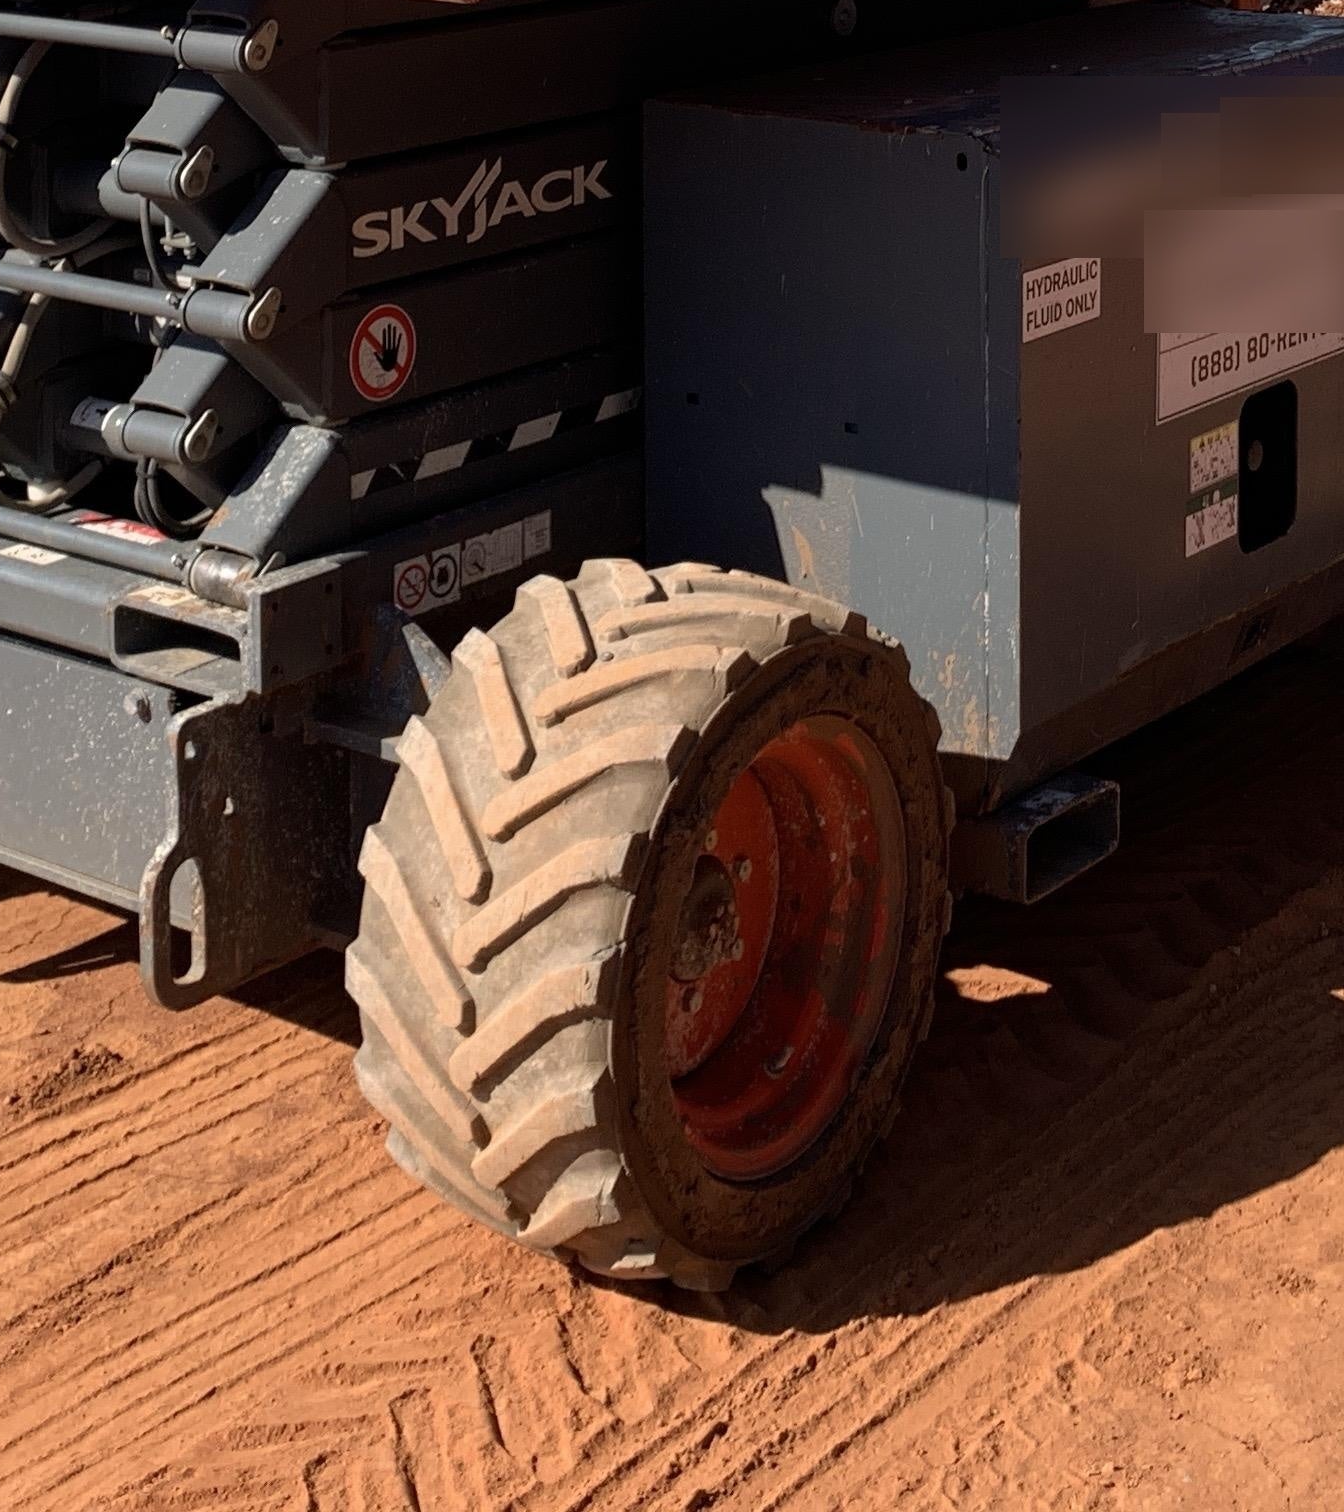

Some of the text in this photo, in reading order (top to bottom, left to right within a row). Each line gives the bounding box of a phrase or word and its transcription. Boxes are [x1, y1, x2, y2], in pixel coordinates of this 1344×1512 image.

[352, 156, 613, 258] SKYJACK
[1026, 260, 1098, 300] HYDRAULIC
[1026, 289, 1097, 332] FLUID ONLY
[1191, 332, 1327, 387] (888) 80-RE
